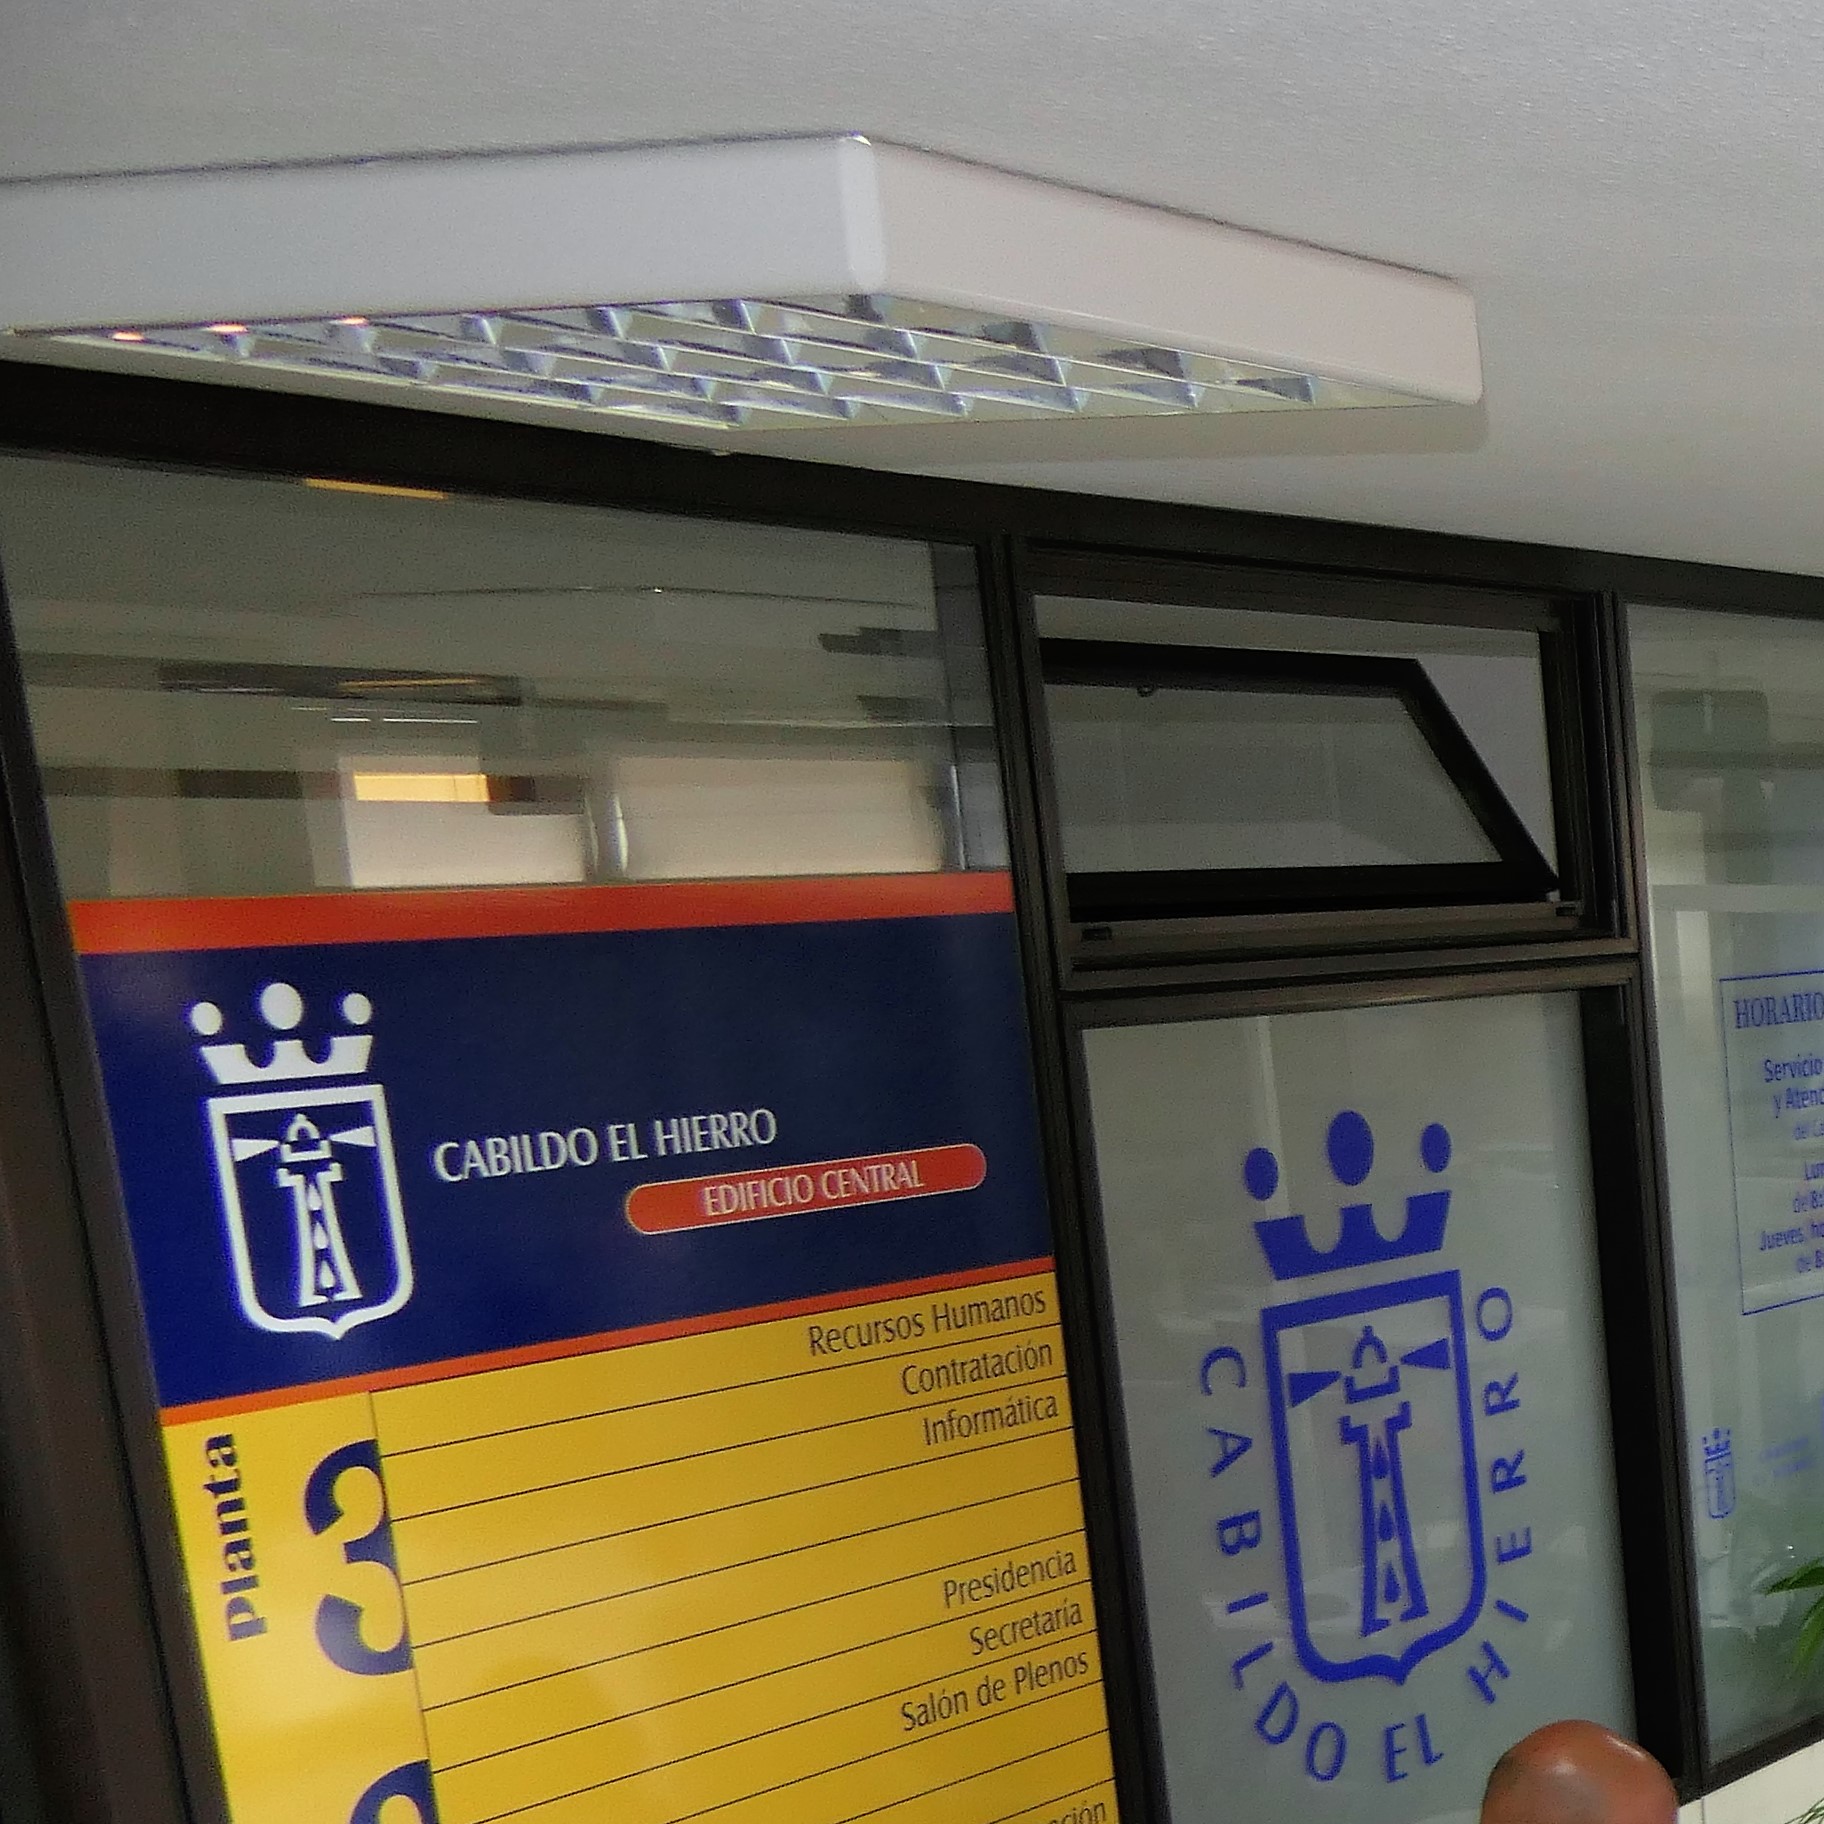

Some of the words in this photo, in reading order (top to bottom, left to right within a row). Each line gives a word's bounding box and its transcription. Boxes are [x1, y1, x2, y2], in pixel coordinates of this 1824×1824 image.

[1764, 1052, 1822, 1083] Servicio
[433, 1127, 598, 1183] CABILDO
[608, 1122, 648, 1163] EL
[654, 1108, 778, 1156] HIERRO
[704, 1173, 814, 1217] EDIFICIO
[821, 1160, 926, 1199] CENTRAL
[808, 1308, 926, 1356] Recursos
[932, 1289, 1046, 1334] Humanos
[901, 1340, 1053, 1396] Contratación
[923, 1394, 1059, 1446] Informática
[202, 1430, 271, 1642] Planta
[304, 1440, 413, 1676] 3
[1200, 1344, 1349, 1782] CABILDO
[1383, 1711, 1445, 1783] EL
[1466, 1285, 1535, 1705] HIERRO
[943, 1550, 1078, 1609] Presidencia
[970, 1598, 1083, 1656] Secretaría
[901, 1688, 968, 1731] Salón
[977, 1675, 1006, 1706] de
[1014, 1651, 1089, 1695] Plenos
